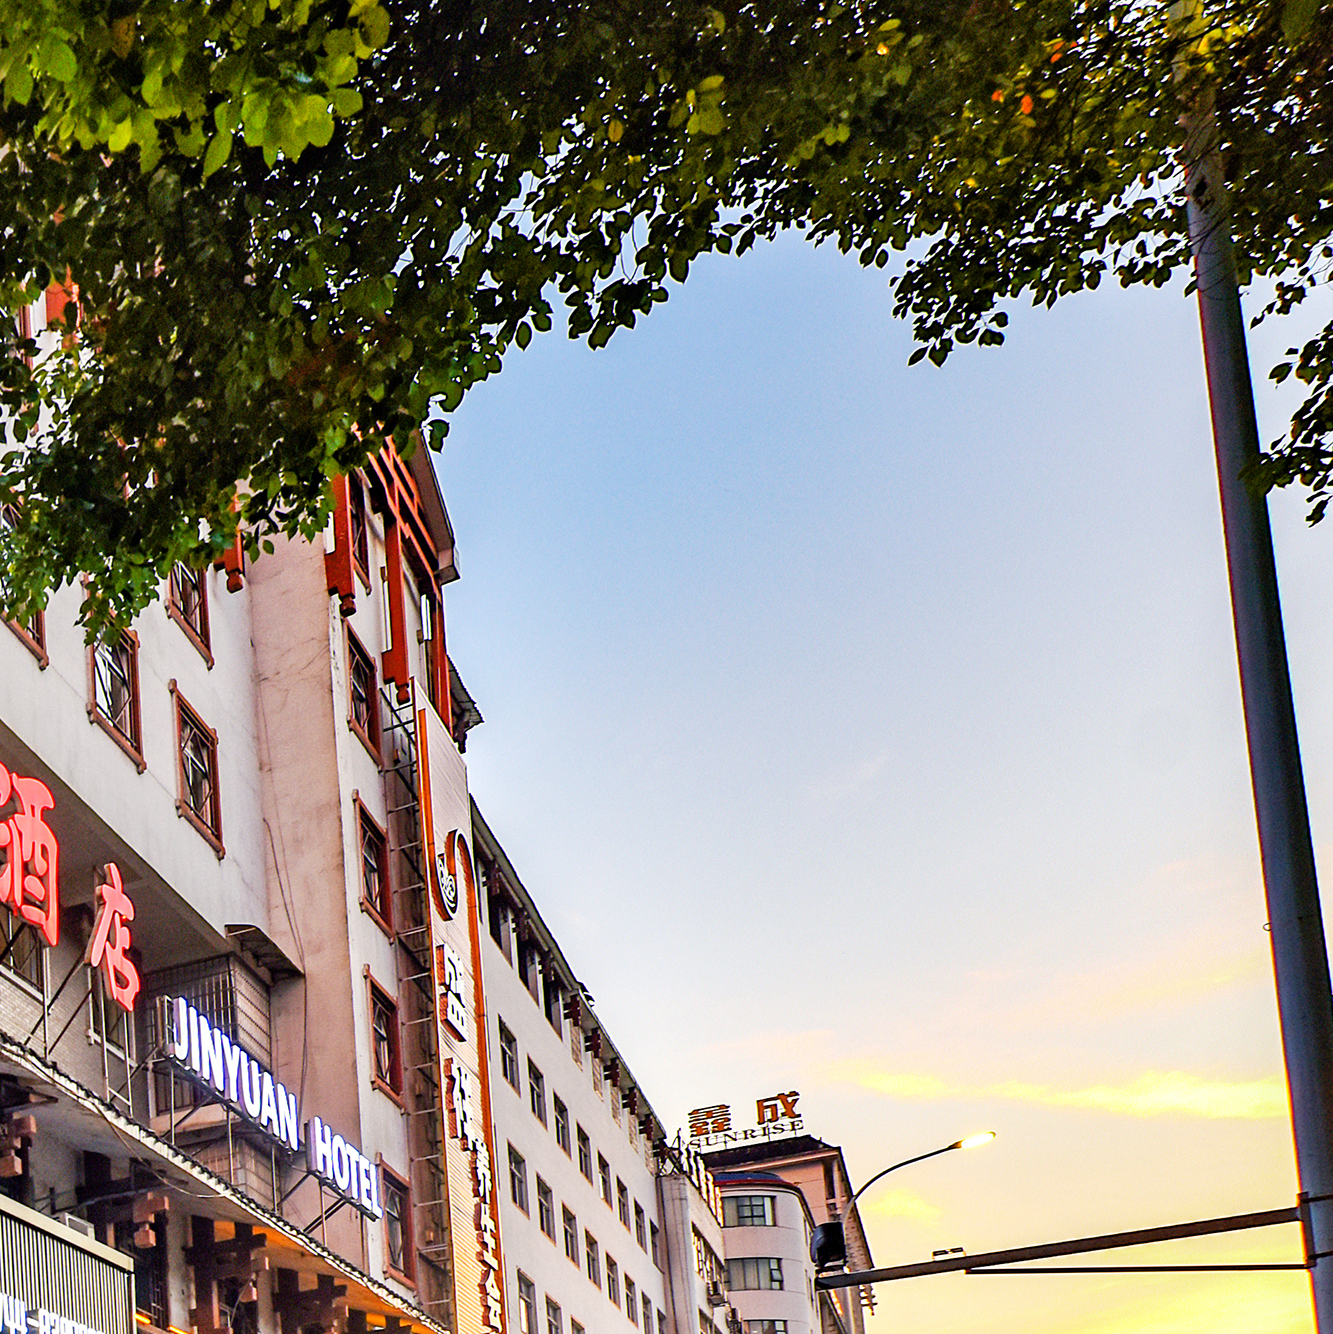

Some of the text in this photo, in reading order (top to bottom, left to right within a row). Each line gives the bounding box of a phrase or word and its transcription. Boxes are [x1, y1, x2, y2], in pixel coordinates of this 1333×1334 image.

[173, 996, 383, 1219] JINYUAN HOTEL
[689, 1120, 804, 1149] SUNRISE
